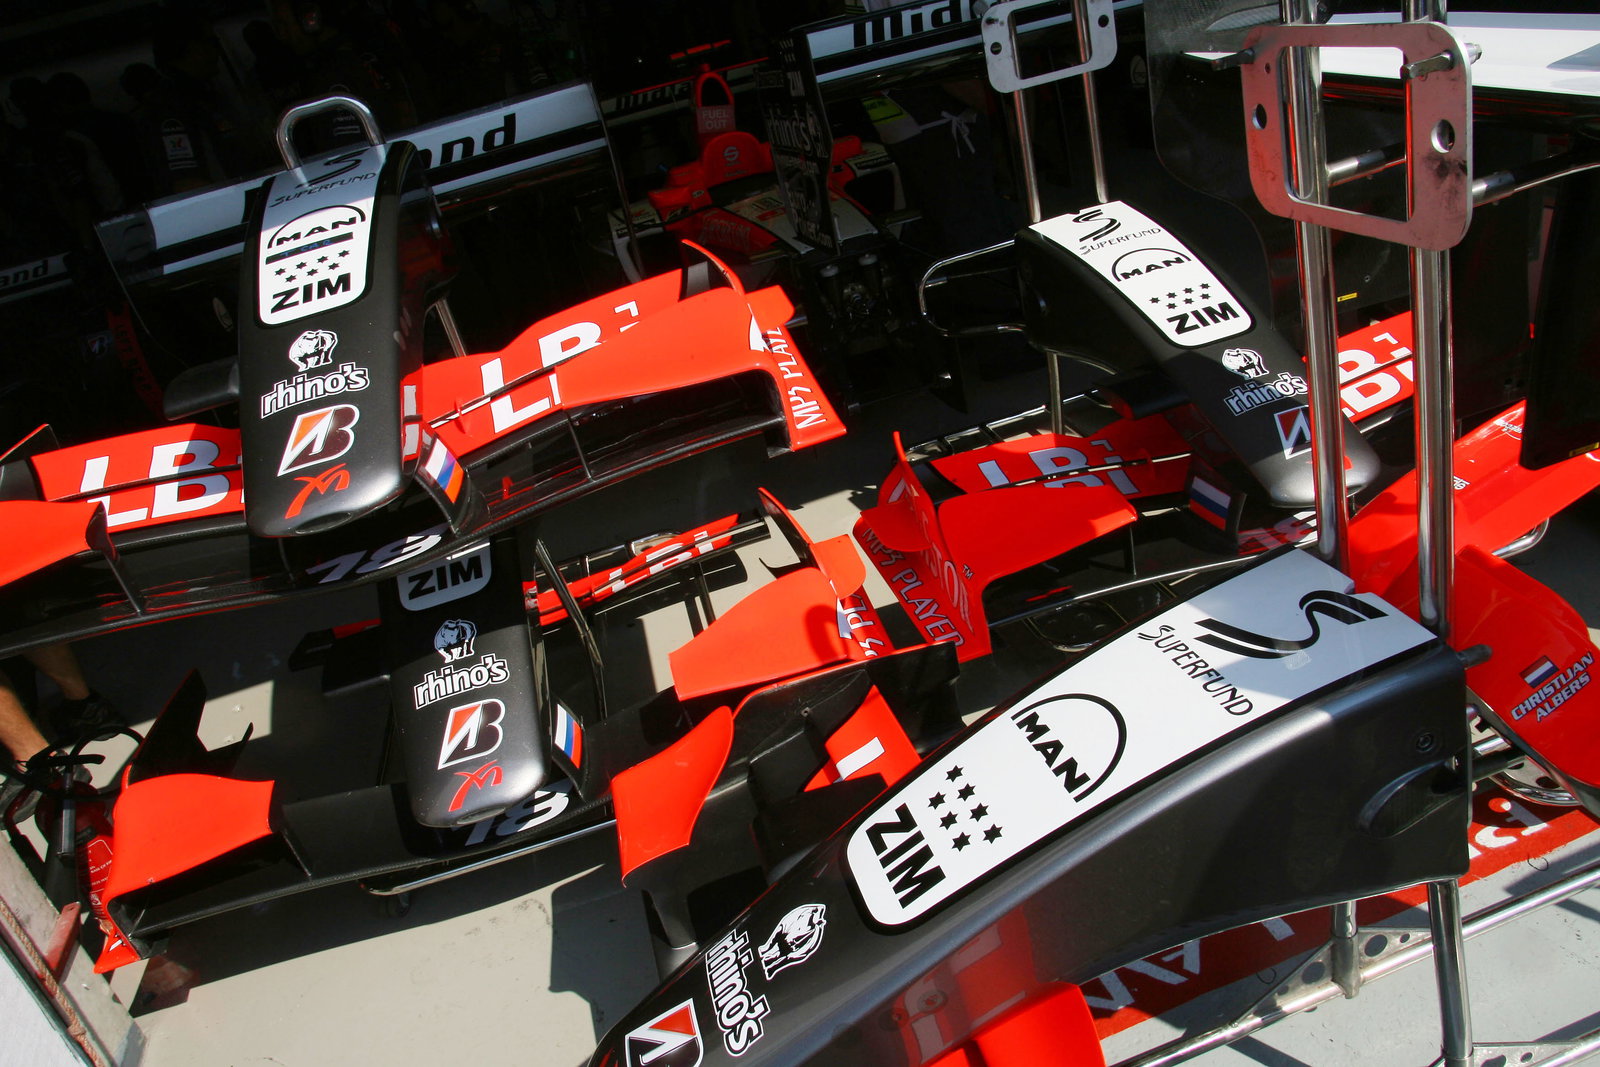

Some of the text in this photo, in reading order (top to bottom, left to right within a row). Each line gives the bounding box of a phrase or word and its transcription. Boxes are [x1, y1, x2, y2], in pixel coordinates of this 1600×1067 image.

[702, 108, 729, 119] FUEL
[705, 119, 728, 130] OUT
[269, 172, 377, 208] SUPERFUND
[276, 216, 357, 247] MAN
[1079, 227, 1162, 256] SUPERFUND
[1120, 256, 1185, 281] MAN
[270, 272, 352, 315] ZIM
[1166, 301, 1240, 336] ZIM
[261, 362, 370, 419] rhino's
[1224, 371, 1308, 416] rhino's
[408, 554, 484, 600] ZIM
[415, 653, 510, 711] rhino's
[1138, 625, 1254, 717] SUPERFUND
[1511, 652, 1594, 721] CHRISTIJAN
[1536, 671, 1591, 722] ALBERS
[1016, 711, 1091, 793] MAN
[866, 802, 946, 909] ZIM
[705, 929, 771, 1057] rhino's
